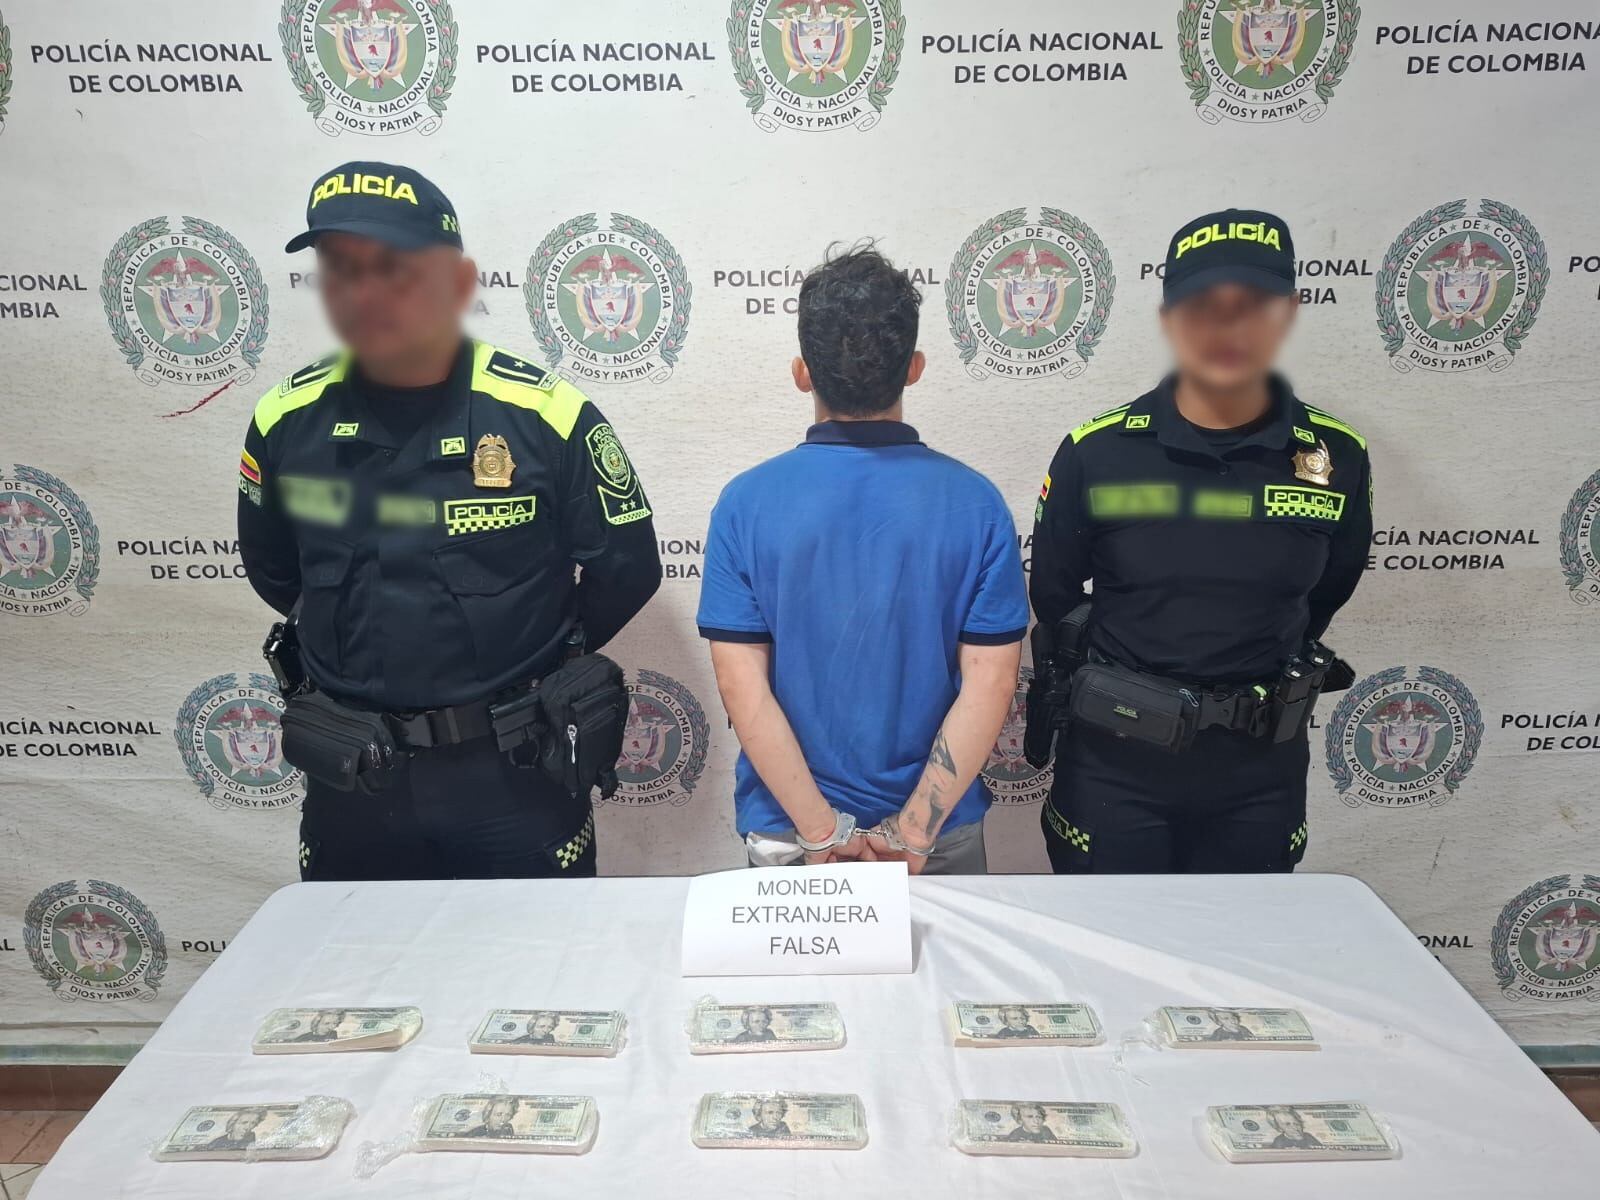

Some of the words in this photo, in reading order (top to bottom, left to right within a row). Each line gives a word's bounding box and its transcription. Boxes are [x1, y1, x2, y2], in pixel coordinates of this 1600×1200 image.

[922, 29, 1021, 53] POLICÍA
[1030, 32, 1163, 51] NACIONAL
[1375, 20, 1477, 45] POLICÍA
[1486, 23, 1600, 42] NACIONA
[31, 38, 131, 63] POLICÍA
[138, 44, 272, 62] NACIONAL
[476, 39, 576, 63] POLICÍA
[583, 42, 715, 62] NACIONAL
[954, 65, 985, 84] DE
[994, 63, 1128, 82] COLOMBIA
[1407, 57, 1440, 75] DE
[1447, 53, 1586, 73] COLOMBIA
[69, 76, 102, 93] DE
[108, 74, 243, 93] COLOMBIA
[512, 75, 543, 93] DE
[551, 74, 683, 92] COLOMBIA
[818, 66, 876, 109] NACIONAL
[1263, 57, 1327, 101] NACIONAL
[379, 71, 433, 115] NACIONAL
[818, 107, 862, 127] PATRIA
[1262, 98, 1308, 119] PATRIA
[380, 111, 422, 131] PATRIA
[311, 174, 418, 208] POLICÍA
[1176, 222, 1281, 260] POLICÍA
[1026, 228, 1043, 237] DE
[1057, 236, 1093, 303] COLOMBIA
[1298, 259, 1373, 276] IONAL
[1463, 220, 1481, 229] DE
[1494, 228, 1526, 296] COLOMBIA
[171, 236, 188, 245] DE
[204, 244, 249, 311] COLOMBIA
[598, 234, 615, 243] DE
[630, 242, 671, 309] COLOMBIA
[714, 265, 805, 287] POLICÍA
[0, 275, 87, 292] CIONAL
[0, 303, 59, 319] MBIA
[746, 298, 775, 314] DE
[1027, 320, 1086, 359] NACIONAL
[1454, 312, 1514, 352] NACIONAL
[195, 327, 247, 365] NACIONAL
[613, 325, 667, 364] NACIONAL
[1027, 357, 1069, 375] PATRIA
[1451, 350, 1495, 368] PATRIA
[197, 363, 237, 381] PATRIA
[614, 362, 655, 379] PATRIA
[1275, 492, 1334, 509] POLICÍA
[5, 482, 21, 490] DE
[36, 489, 81, 549] COLOMBIA
[454, 503, 527, 519] POLICÍA
[1581, 496, 1600, 537] REPUB
[118, 536, 207, 556] POLICÍA
[1419, 530, 1539, 545] NACIONAL
[151, 565, 179, 579] DE
[186, 564, 248, 579] COLO
[1365, 556, 1376, 570] E
[1384, 555, 1504, 570] COLOMBIA
[31, 564, 79, 599] NACIONAL
[0, 601, 21, 611] IOS
[33, 597, 72, 613] PATRIA
[0, 718, 43, 734] ICÍA
[49, 721, 161, 734] NACIONAL
[655, 692, 691, 746] COLOMBIA
[1432, 689, 1463, 746] COLOMBIA
[1501, 711, 1587, 728] POLICÍA
[0, 744, 18, 757] E
[24, 743, 137, 757] COLOMBIA
[1527, 738, 1554, 750] DE
[260, 771, 298, 795] NACION
[638, 760, 686, 791] NACIONAL
[1012, 768, 1054, 789] NACION
[1399, 759, 1454, 791] NACIONAL
[262, 792, 299, 807] PATRIA
[638, 789, 675, 804] PATRIA
[1011, 788, 1048, 802] PATRIA
[1397, 790, 1436, 805] PATRIA
[758, 879, 853, 895] MONEDA
[107, 901, 149, 948] COLOMBIA
[732, 906, 878, 923] EXTRANJERA
[182, 941, 225, 952] POLI
[770, 937, 840, 954] FALSA
[1417, 935, 1473, 948] ONAL
[104, 959, 150, 988] NACIONAL
[1558, 967, 1600, 987] NACION
[107, 988, 140, 999] PATRIA
[1555, 986, 1594, 999] PATRIA
